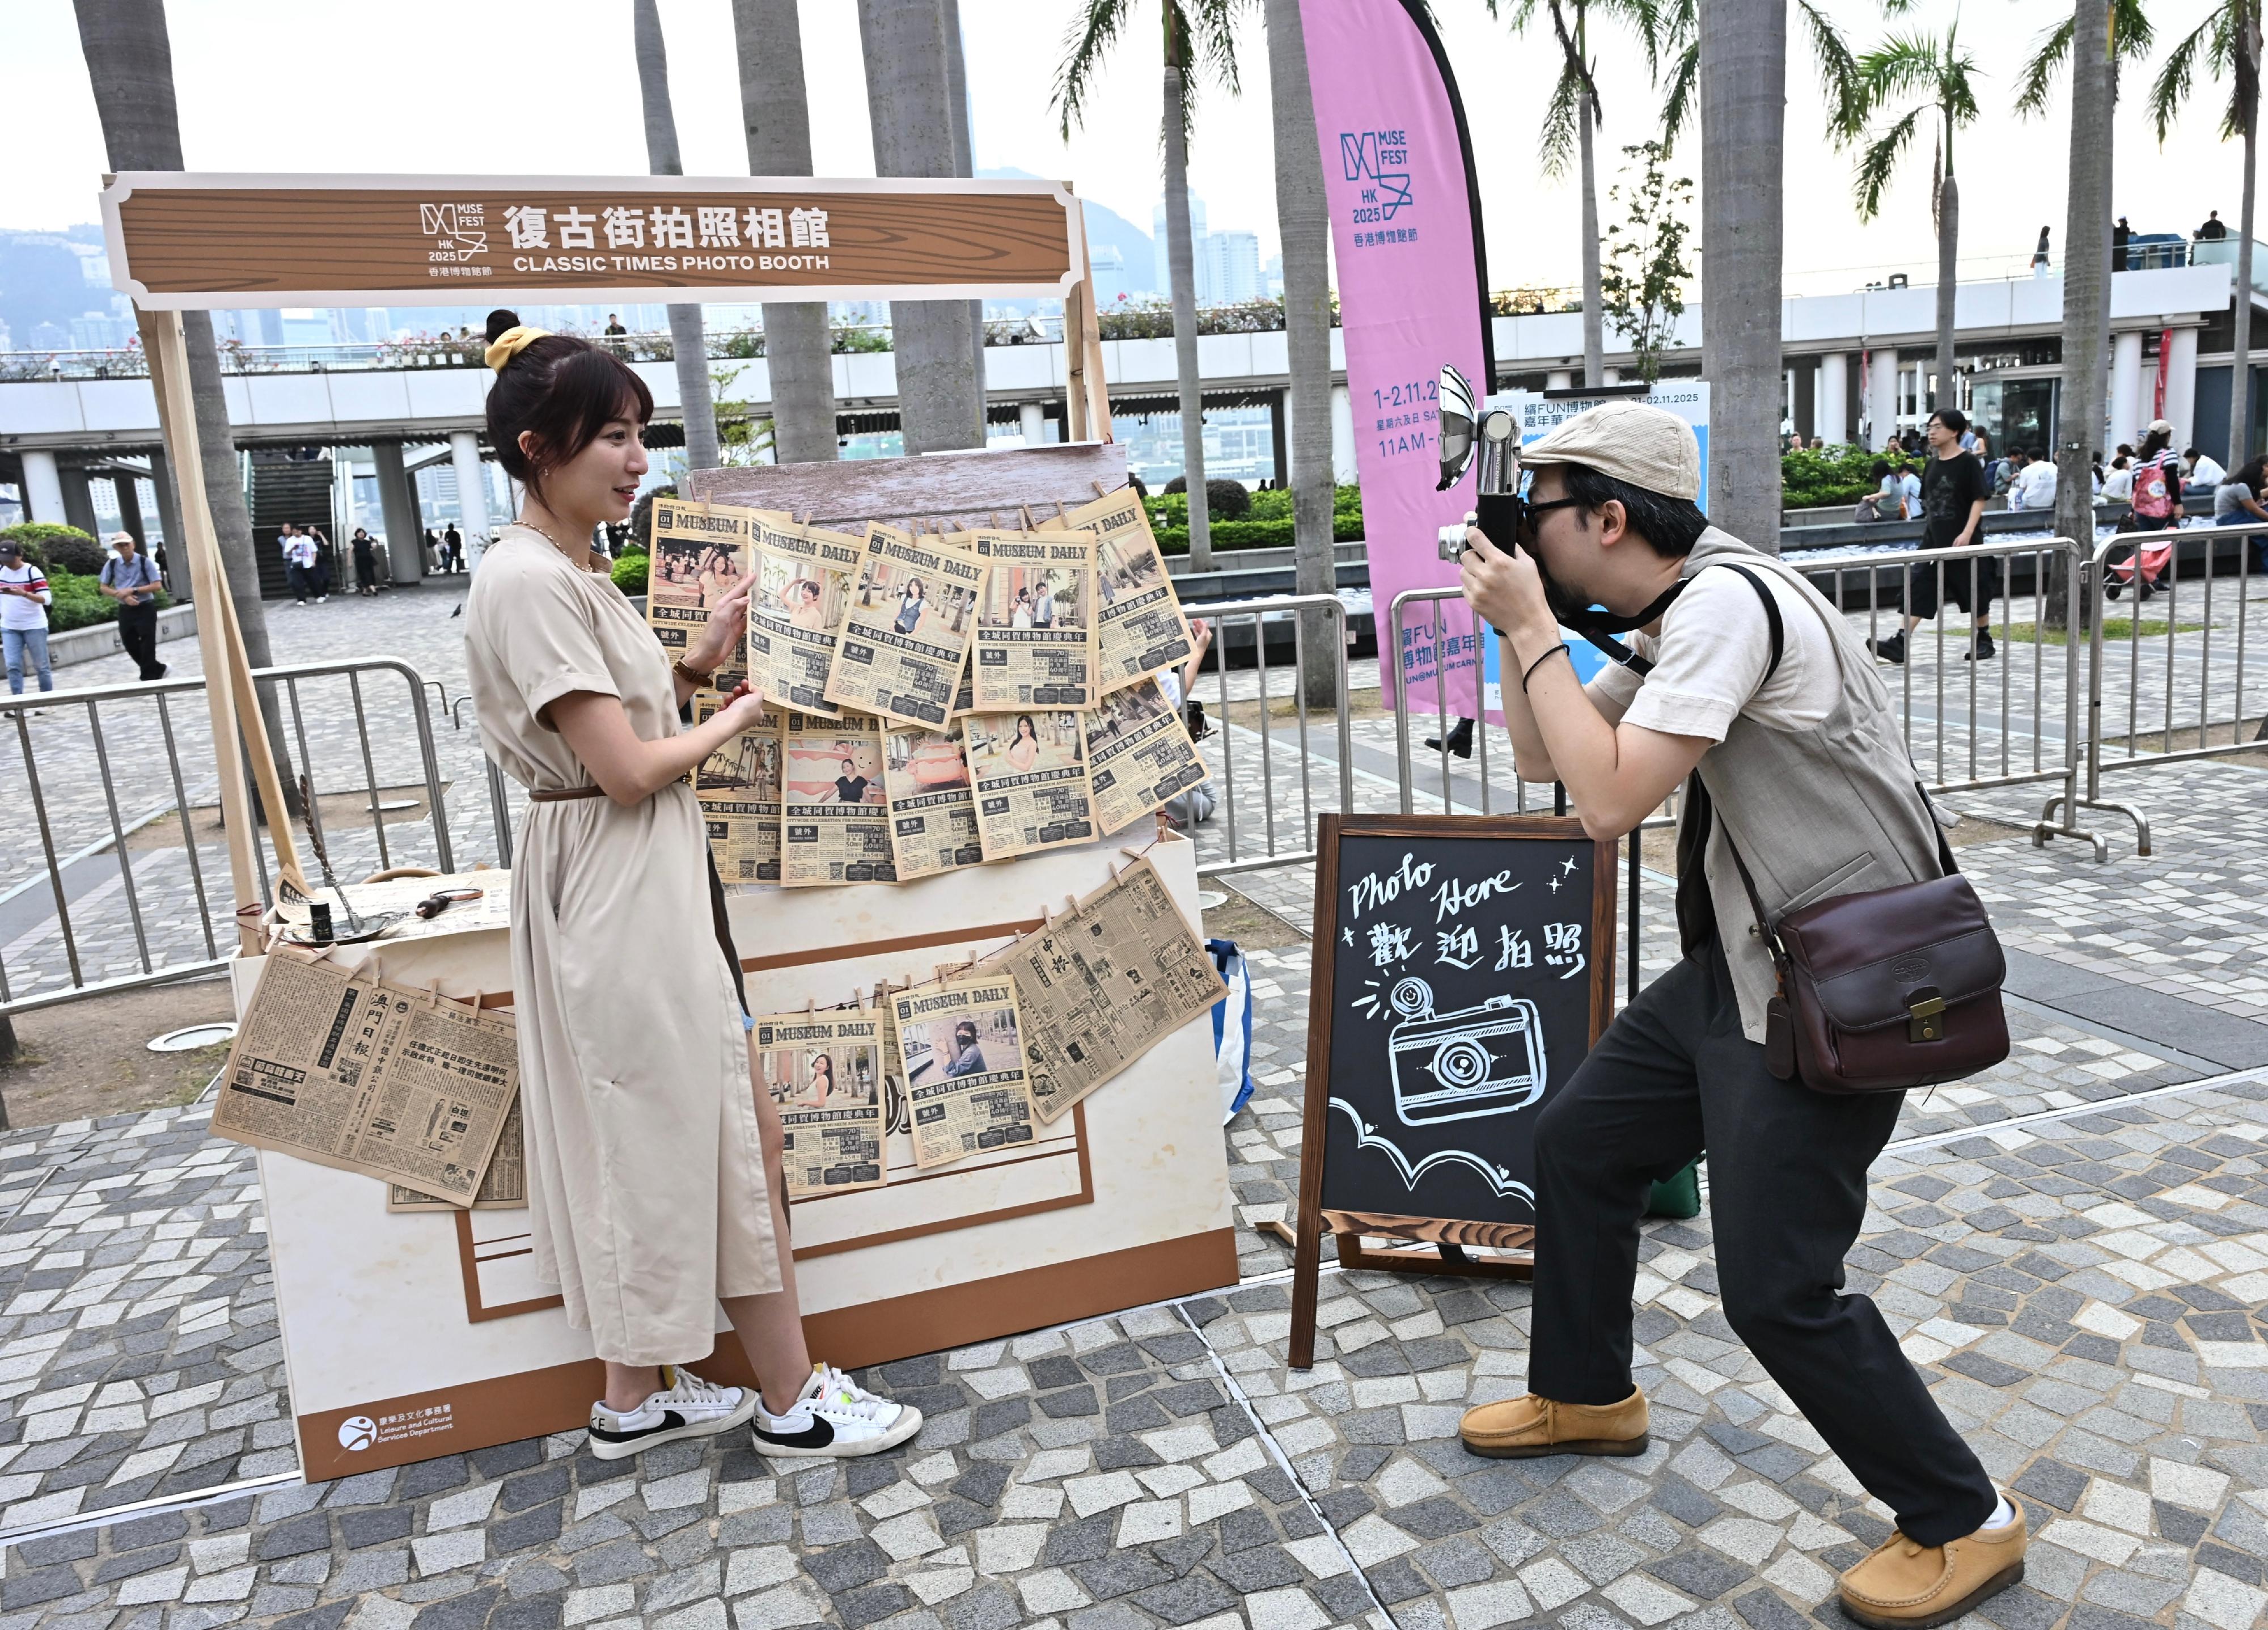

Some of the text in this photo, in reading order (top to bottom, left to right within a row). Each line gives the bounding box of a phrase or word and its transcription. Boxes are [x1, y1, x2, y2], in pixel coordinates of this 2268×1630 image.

[1378, 130, 1406, 145] MUSE
[1381, 150, 1407, 164] FEST
[1361, 189, 1378, 203] HK
[457, 204, 484, 214] MUSE
[1353, 208, 1381, 223] 2025
[459, 217, 484, 226] FEST
[502, 205, 830, 250] 復古街拍照相館
[438, 240, 454, 249] HK
[1354, 228, 1418, 247] 香港博物館節
[428, 252, 456, 261] 2025
[513, 255, 830, 272] CLASSIC TIMES PHOTO BOOTH
[429, 267, 492, 277] 香港博物館節
[1377, 413, 1419, 431] 星期六及日
[1379, 432, 1440, 458] 11AM-
[676, 513, 738, 534] MUSEUM
[1101, 508, 1137, 532] DAILY
[762, 530, 860, 564] MUSEUM DAILY
[871, 540, 881, 549] 01
[992, 543, 1088, 560] MUSEUM DAILY
[883, 541, 983, 581] MUSEUM DAILY
[657, 608, 709, 622] 全城同賀
[852, 623, 957, 661] 全城同賀博物館慶典年
[982, 631, 1084, 642] 全城同賀博物館慶典年
[806, 715, 864, 730] MUSEUM
[981, 768, 1081, 791] 全城同賀博物館慶典年
[896, 791, 972, 810] 全城同賀博物館
[1348, 852, 1523, 924] Photo Here
[1366, 922, 1586, 979] 歡迎拍照
[913, 992, 968, 1015] MUSEUM
[972, 987, 1009, 1003] DAILY
[351, 994, 389, 1058] 澳門日報
[776, 1023, 876, 1042] MUSEUM DAILY
[916, 1071, 1020, 1099] 全城同賀博物館慶典年
[922, 1107, 938, 1117] 號外
[378, 1423, 454, 1443] Services Department
[380, 1414, 452, 1434] Leisure and Cultural
